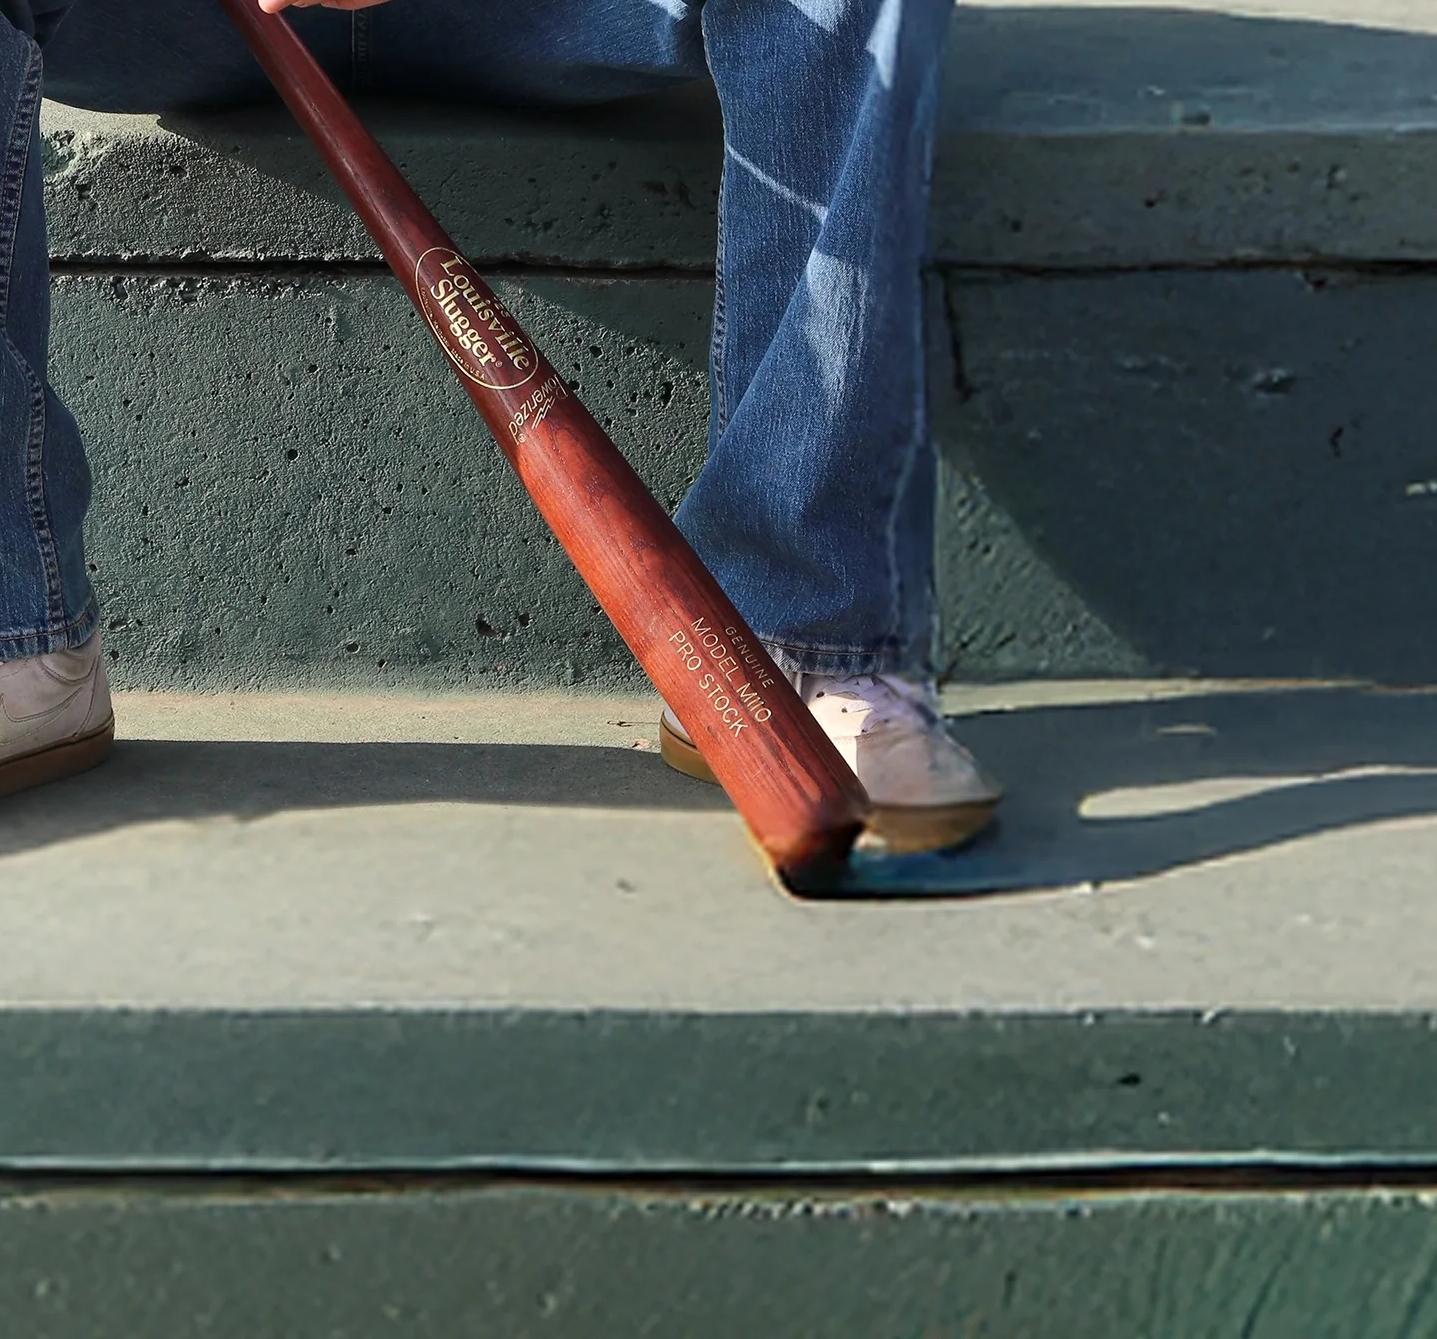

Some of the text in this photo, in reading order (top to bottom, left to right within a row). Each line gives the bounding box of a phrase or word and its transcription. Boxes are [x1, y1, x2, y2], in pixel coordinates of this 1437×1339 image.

[440, 256, 529, 370] Louisville
[669, 630, 748, 738] PRO STOCK
[691, 617, 739, 682] MODEL
[725, 626, 774, 688] GENUINE
